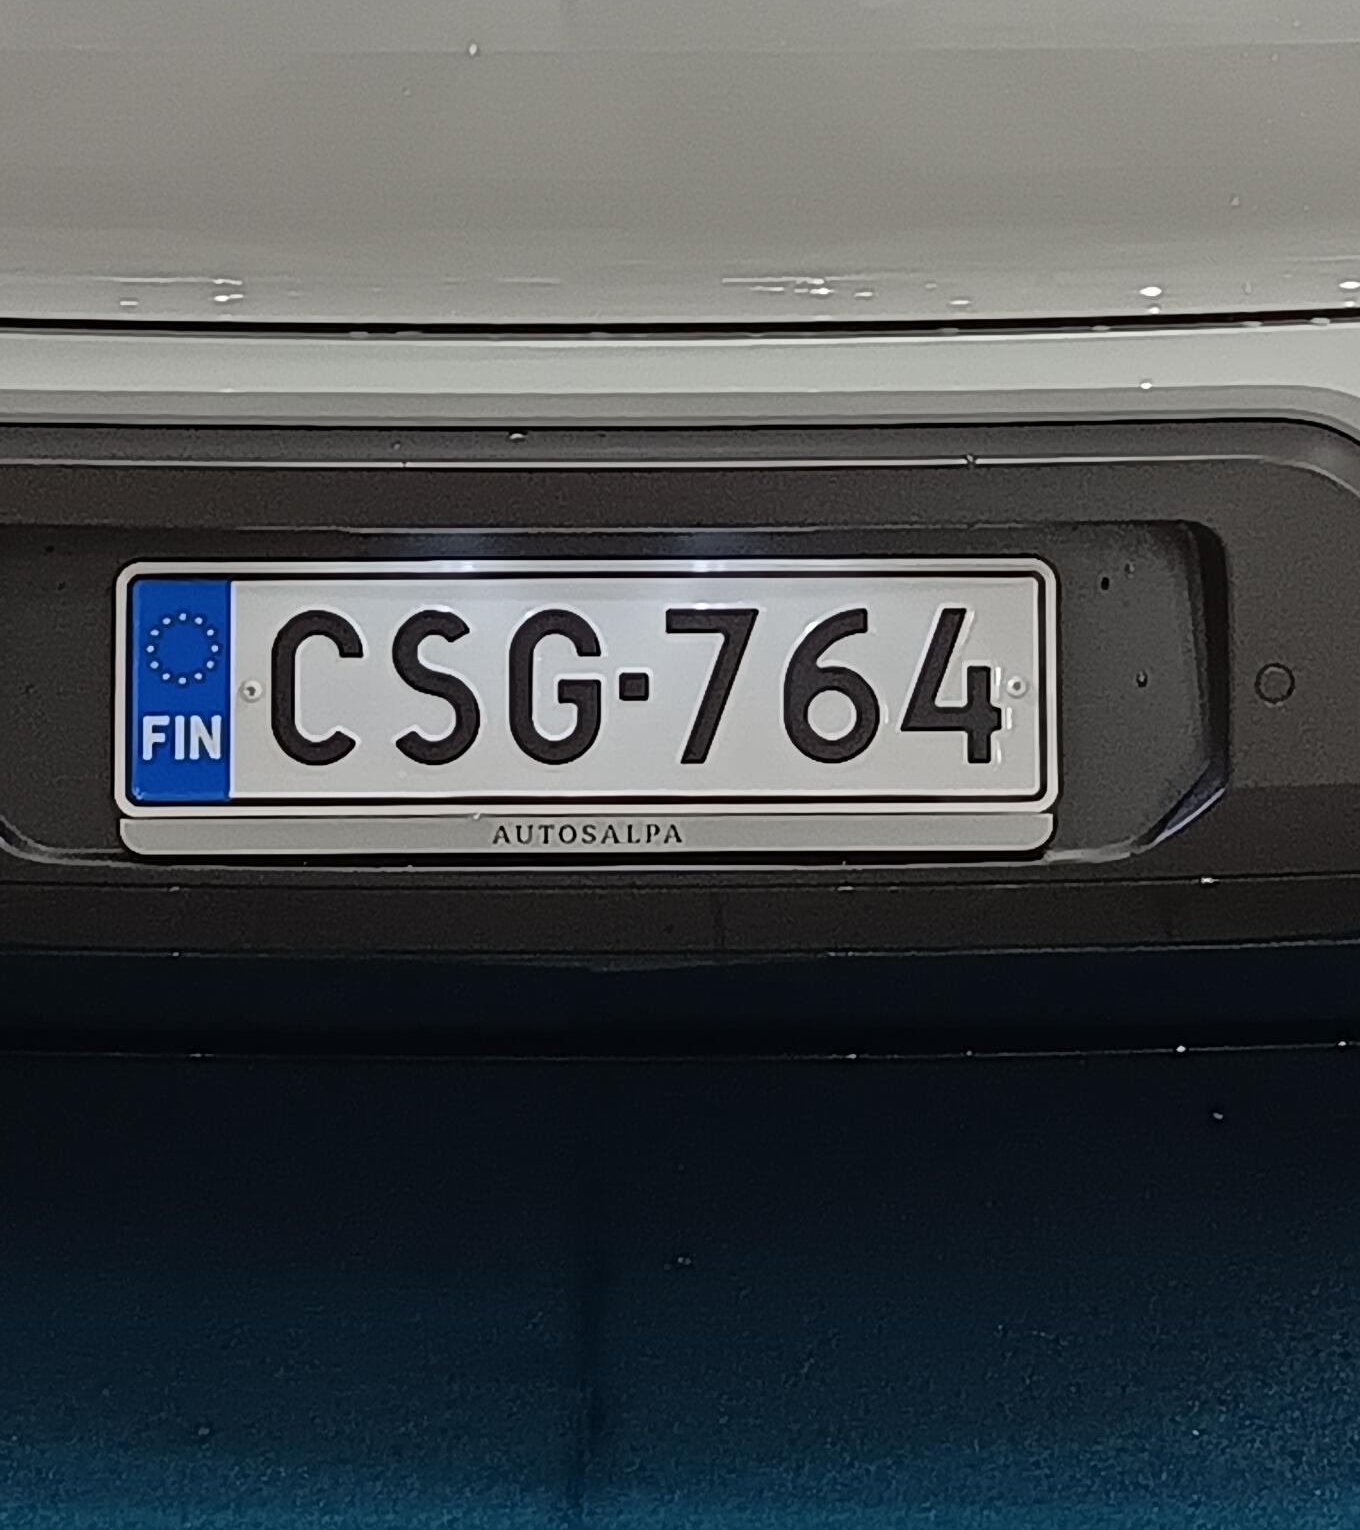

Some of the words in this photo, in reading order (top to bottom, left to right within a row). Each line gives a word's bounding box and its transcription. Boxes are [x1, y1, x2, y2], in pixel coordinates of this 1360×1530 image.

[270, 607, 1003, 767] CSG-764
[142, 714, 222, 761] FIN
[492, 824, 683, 845] AUTOSALPA
